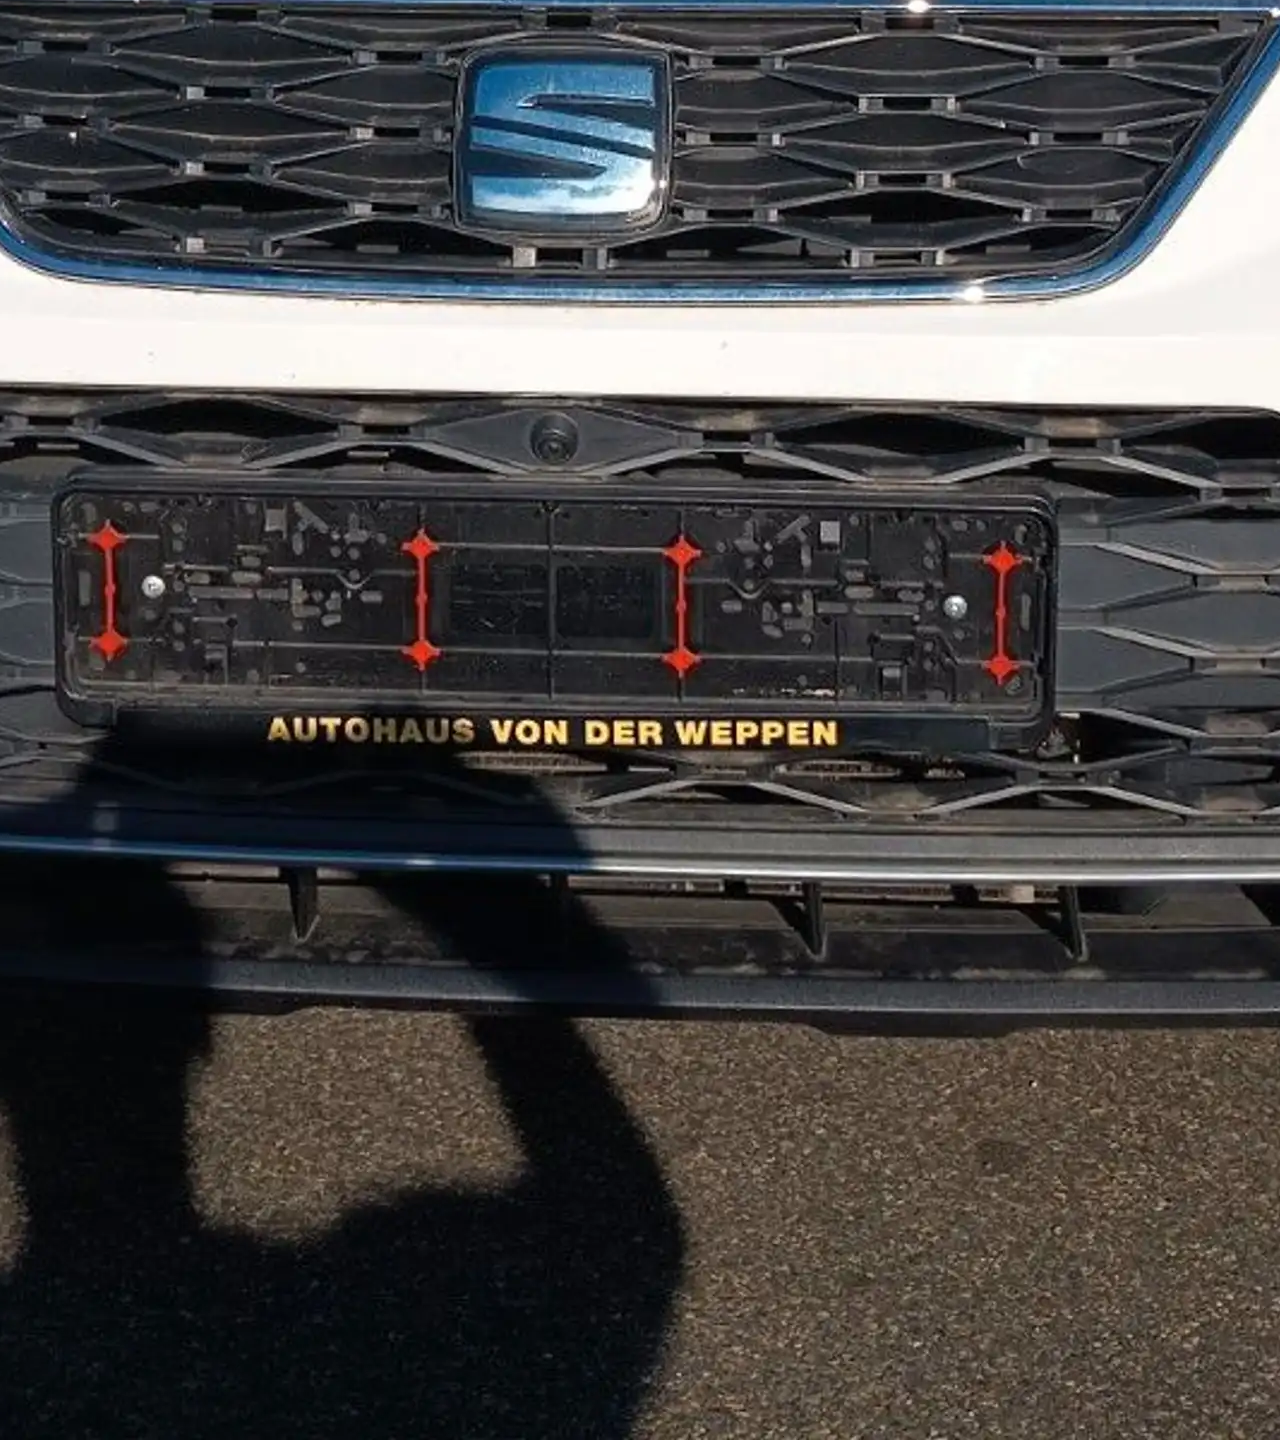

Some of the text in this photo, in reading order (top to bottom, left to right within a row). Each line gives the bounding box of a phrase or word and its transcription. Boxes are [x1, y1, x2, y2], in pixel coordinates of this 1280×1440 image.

[268, 716, 839, 746] AUTOHAUS VON DER WEPPEN
